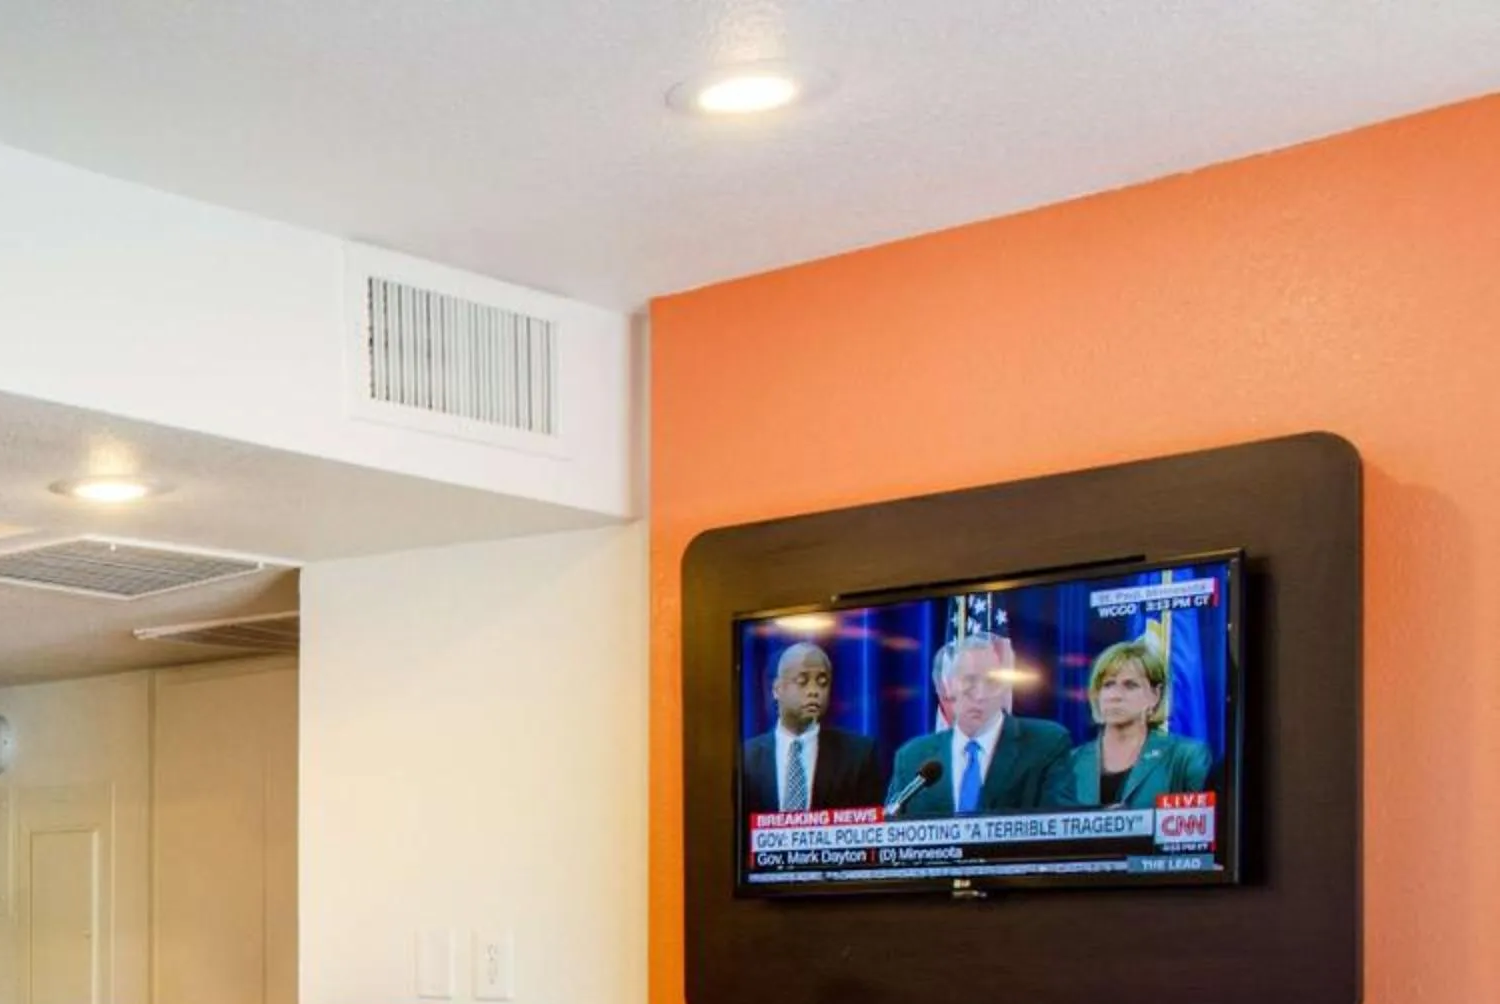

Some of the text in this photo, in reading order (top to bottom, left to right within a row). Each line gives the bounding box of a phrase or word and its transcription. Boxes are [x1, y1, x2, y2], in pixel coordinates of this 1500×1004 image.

[1172, 596, 1191, 608] PM
[1162, 792, 1207, 808] LIVE
[757, 807, 877, 827] BREAKING NEWS
[1162, 814, 1207, 837] CNN
[791, 830, 831, 847] FATAL
[836, 828, 883, 844] POLICE
[887, 824, 960, 842] SHOOTING
[987, 818, 1056, 837] TERRIBLE
[1061, 815, 1143, 834] TRAGEDY"
[758, 846, 963, 866] Gov. Mark Dayton (D) Minnesota
[1142, 857, 1201, 871] THE LEAD
